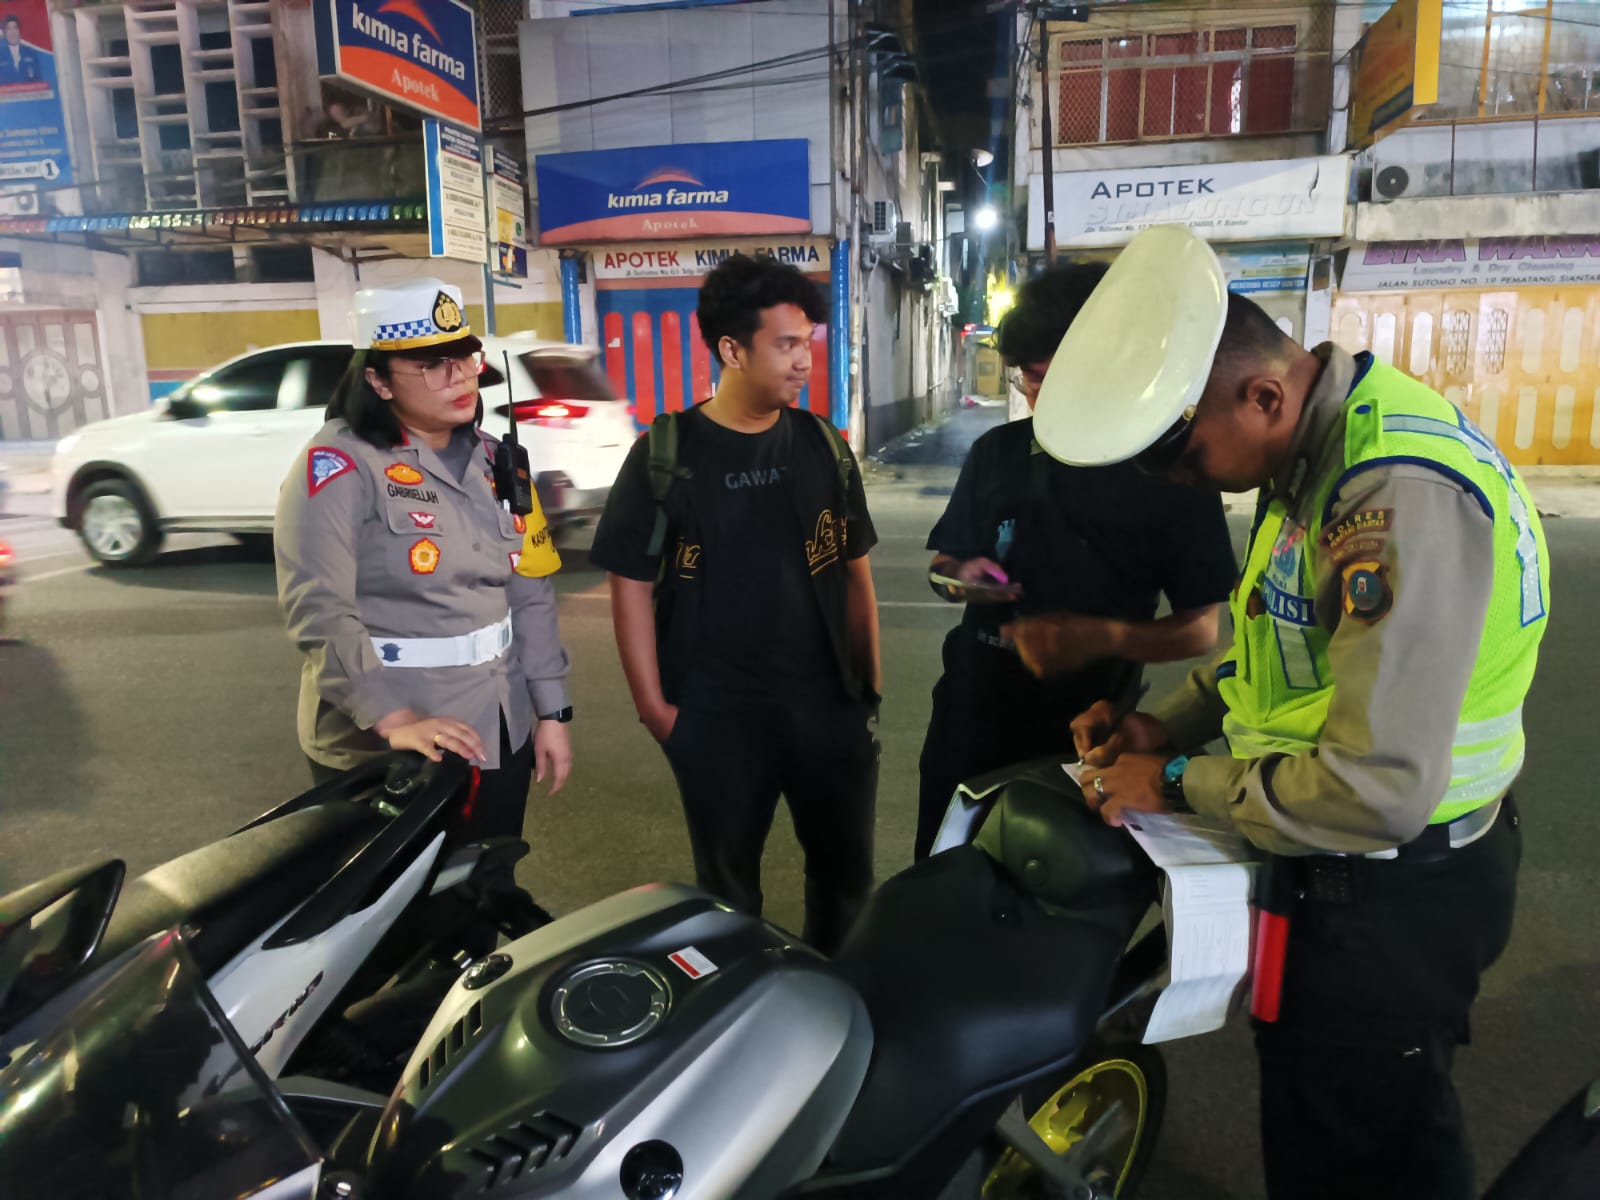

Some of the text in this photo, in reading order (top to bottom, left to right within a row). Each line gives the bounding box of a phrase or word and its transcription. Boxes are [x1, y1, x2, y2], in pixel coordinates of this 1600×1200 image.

[352, 2, 465, 80] kimia farma
[391, 67, 440, 102] Apotek
[46, 162, 54, 177] 1
[607, 188, 729, 209] kimia farma
[642, 218, 699, 233] Apotek
[604, 250, 680, 269] APOTEK
[1413, 265, 1463, 276] Laundry
[1488, 263, 1511, 273] Dry
[1517, 261, 1575, 272] Cleaning
[1377, 280, 1409, 288] JALAN
[1412, 278, 1457, 287] SUTOMO
[1500, 274, 1555, 283] PEMATANG
[387, 482, 440, 504] GABRIELLAH
[1327, 510, 1385, 541] POLRES
